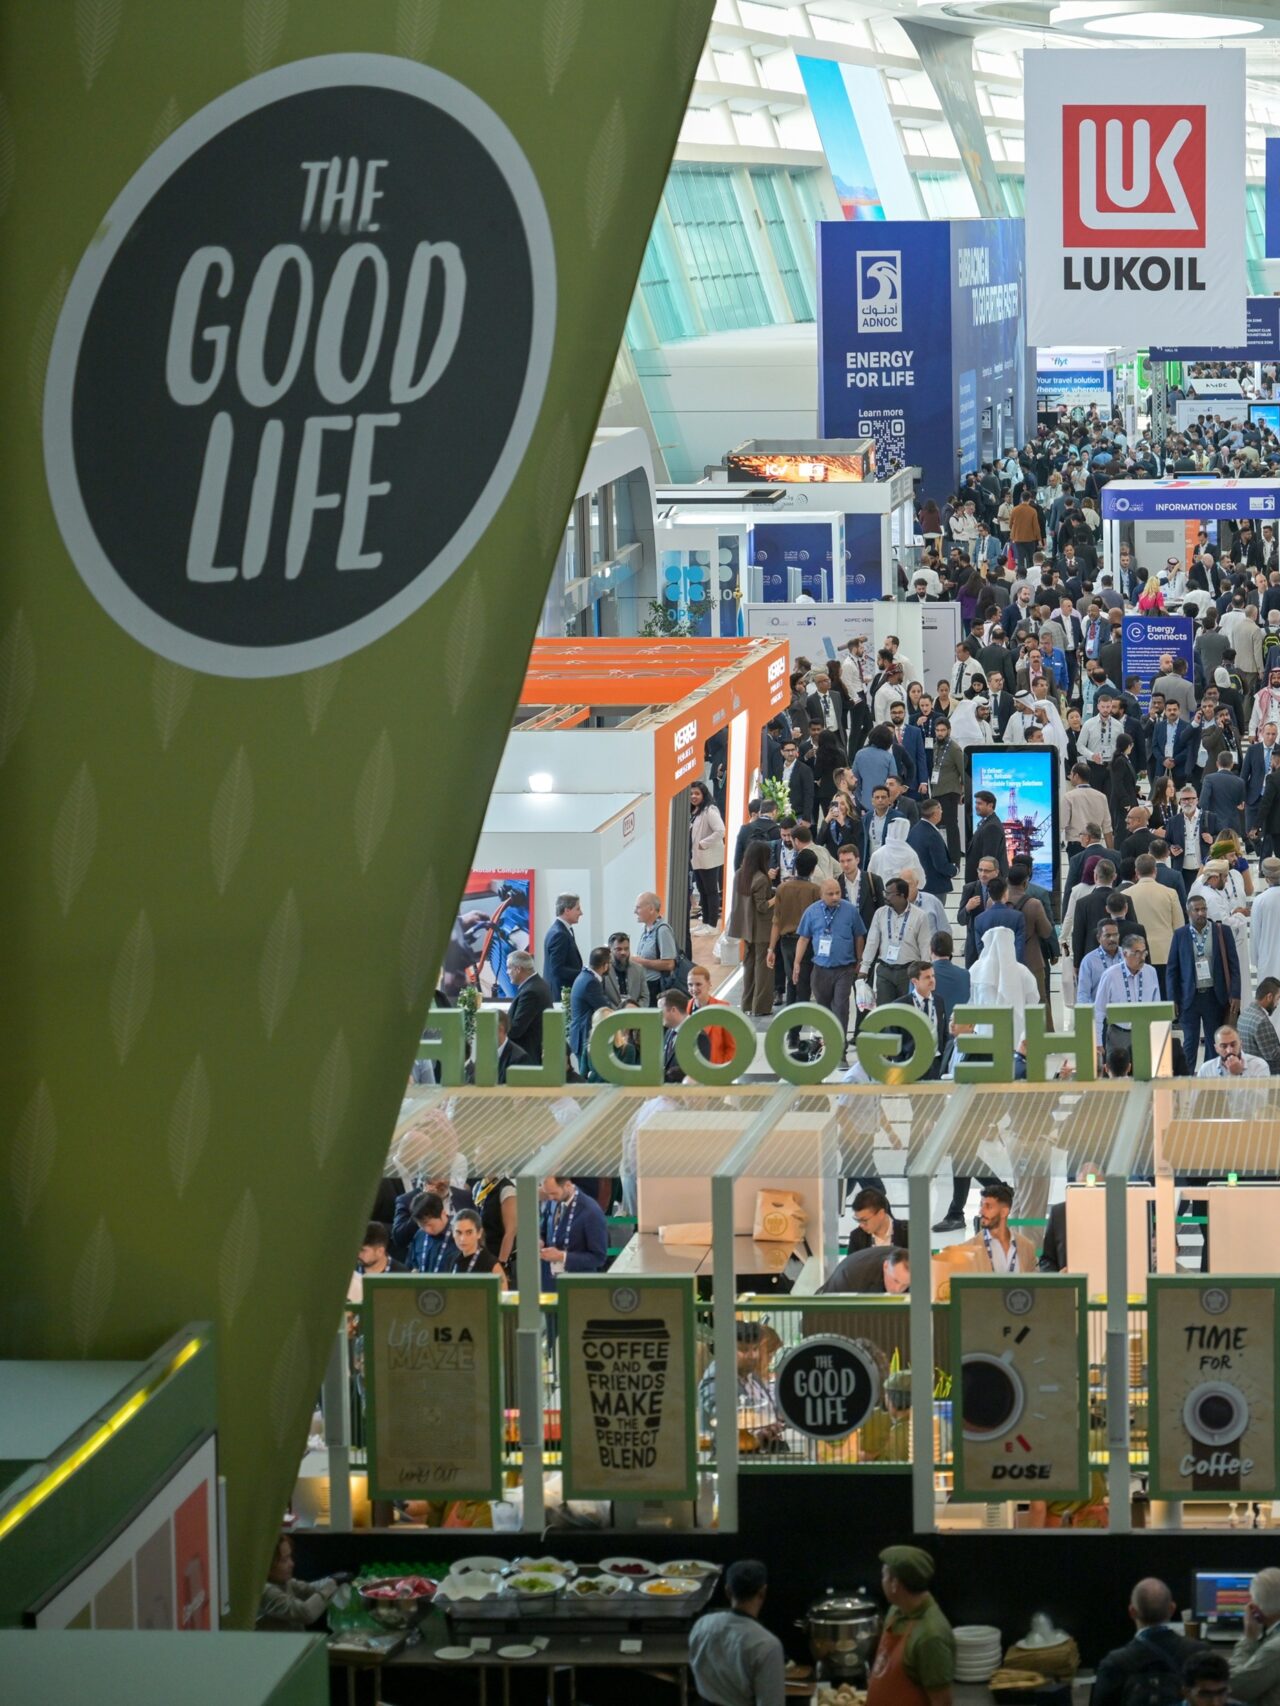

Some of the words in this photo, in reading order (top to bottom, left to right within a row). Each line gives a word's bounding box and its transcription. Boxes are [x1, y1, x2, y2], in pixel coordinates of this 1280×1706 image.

[301, 156, 388, 234] THE
[1064, 256, 1206, 290] LUKOIL
[165, 241, 467, 407] GOOD
[862, 317, 897, 327] ADNOC
[847, 351, 914, 368] ENERGY
[847, 372, 878, 388] FOR
[883, 371, 914, 386] LIFE
[1037, 377, 1051, 385] Your
[1053, 376, 1072, 385] travel
[1073, 376, 1100, 384] solution
[858, 409, 881, 417] Learn
[186, 411, 400, 582] LIFE
[1215, 503, 1237, 511] DESK
[1147, 625, 1176, 635] Energy
[674, 719, 697, 752] KERRY
[387, 1318, 429, 1348] Life
[434, 1328, 452, 1342] IS
[458, 1328, 474, 1342] A
[1003, 1326, 1011, 1337] F
[1184, 1326, 1249, 1352] TIME
[388, 1344, 475, 1371] MAZE
[583, 1341, 670, 1360] COFFEE
[613, 1361, 640, 1373] AND
[815, 1356, 834, 1370] THE
[1200, 1355, 1231, 1371] FOR
[588, 1373, 666, 1391] FRIENDS
[794, 1369, 856, 1399] GOOD
[591, 1391, 664, 1417] MAKE
[805, 1397, 848, 1427] LIFE
[617, 1418, 638, 1430] THE
[597, 1429, 659, 1447] PERFECT
[1005, 1442, 1013, 1453] E
[600, 1446, 657, 1469] BLEND
[1179, 1452, 1254, 1478] Coffee
[992, 1465, 1051, 1480] DOSE
